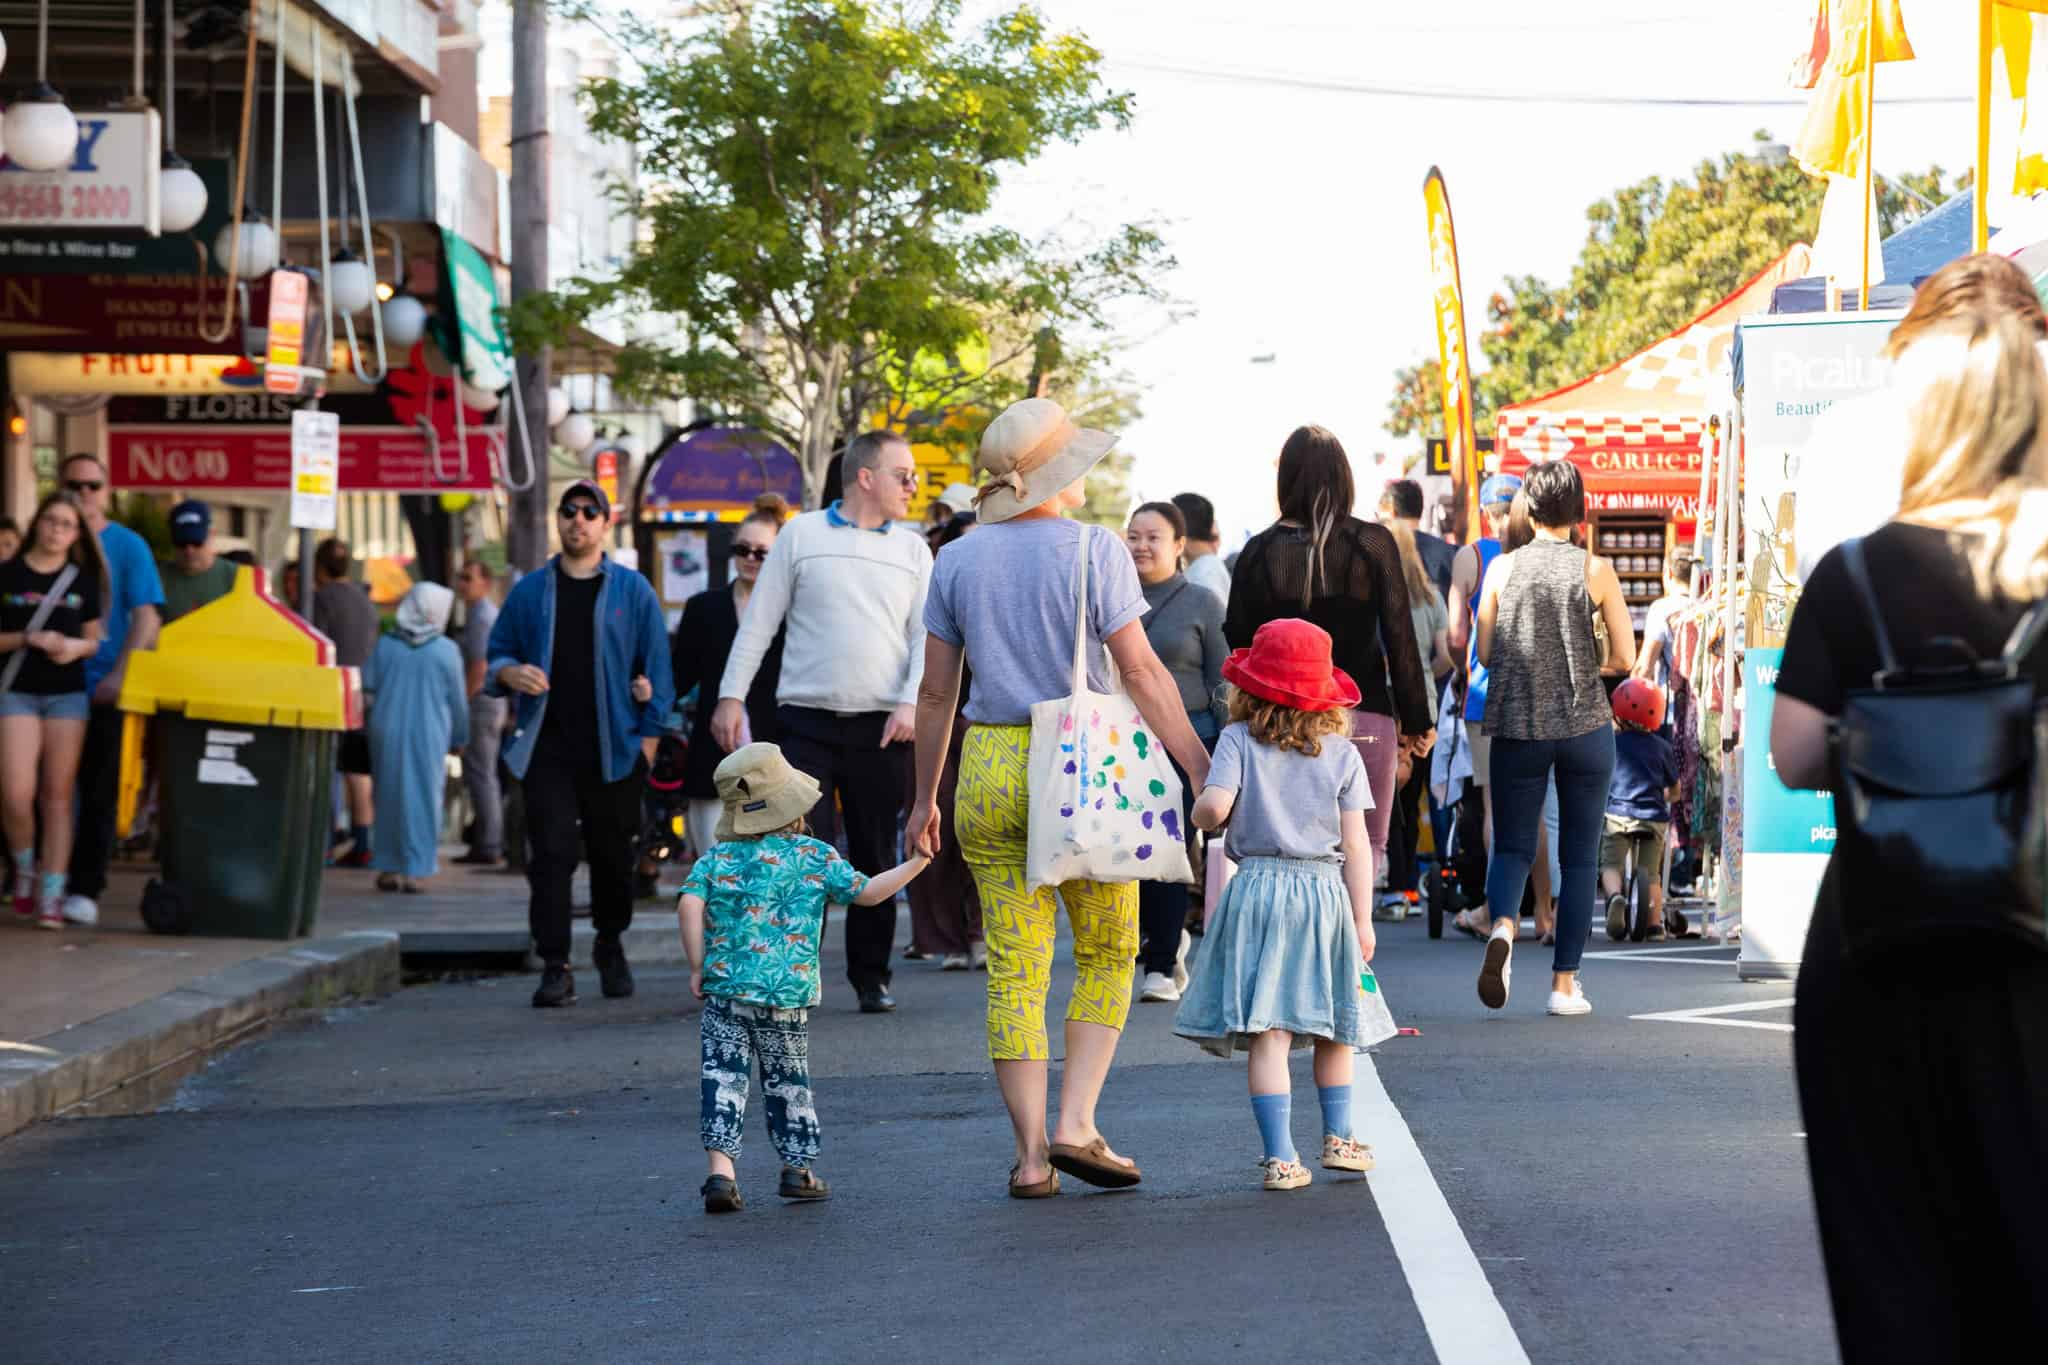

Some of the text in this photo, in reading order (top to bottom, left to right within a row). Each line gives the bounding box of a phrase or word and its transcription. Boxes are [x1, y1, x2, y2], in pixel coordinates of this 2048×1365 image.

[72, 184, 130, 219] 3000
[166, 395, 293, 420] FLORIS
[1590, 451, 1681, 471] GARLIC
